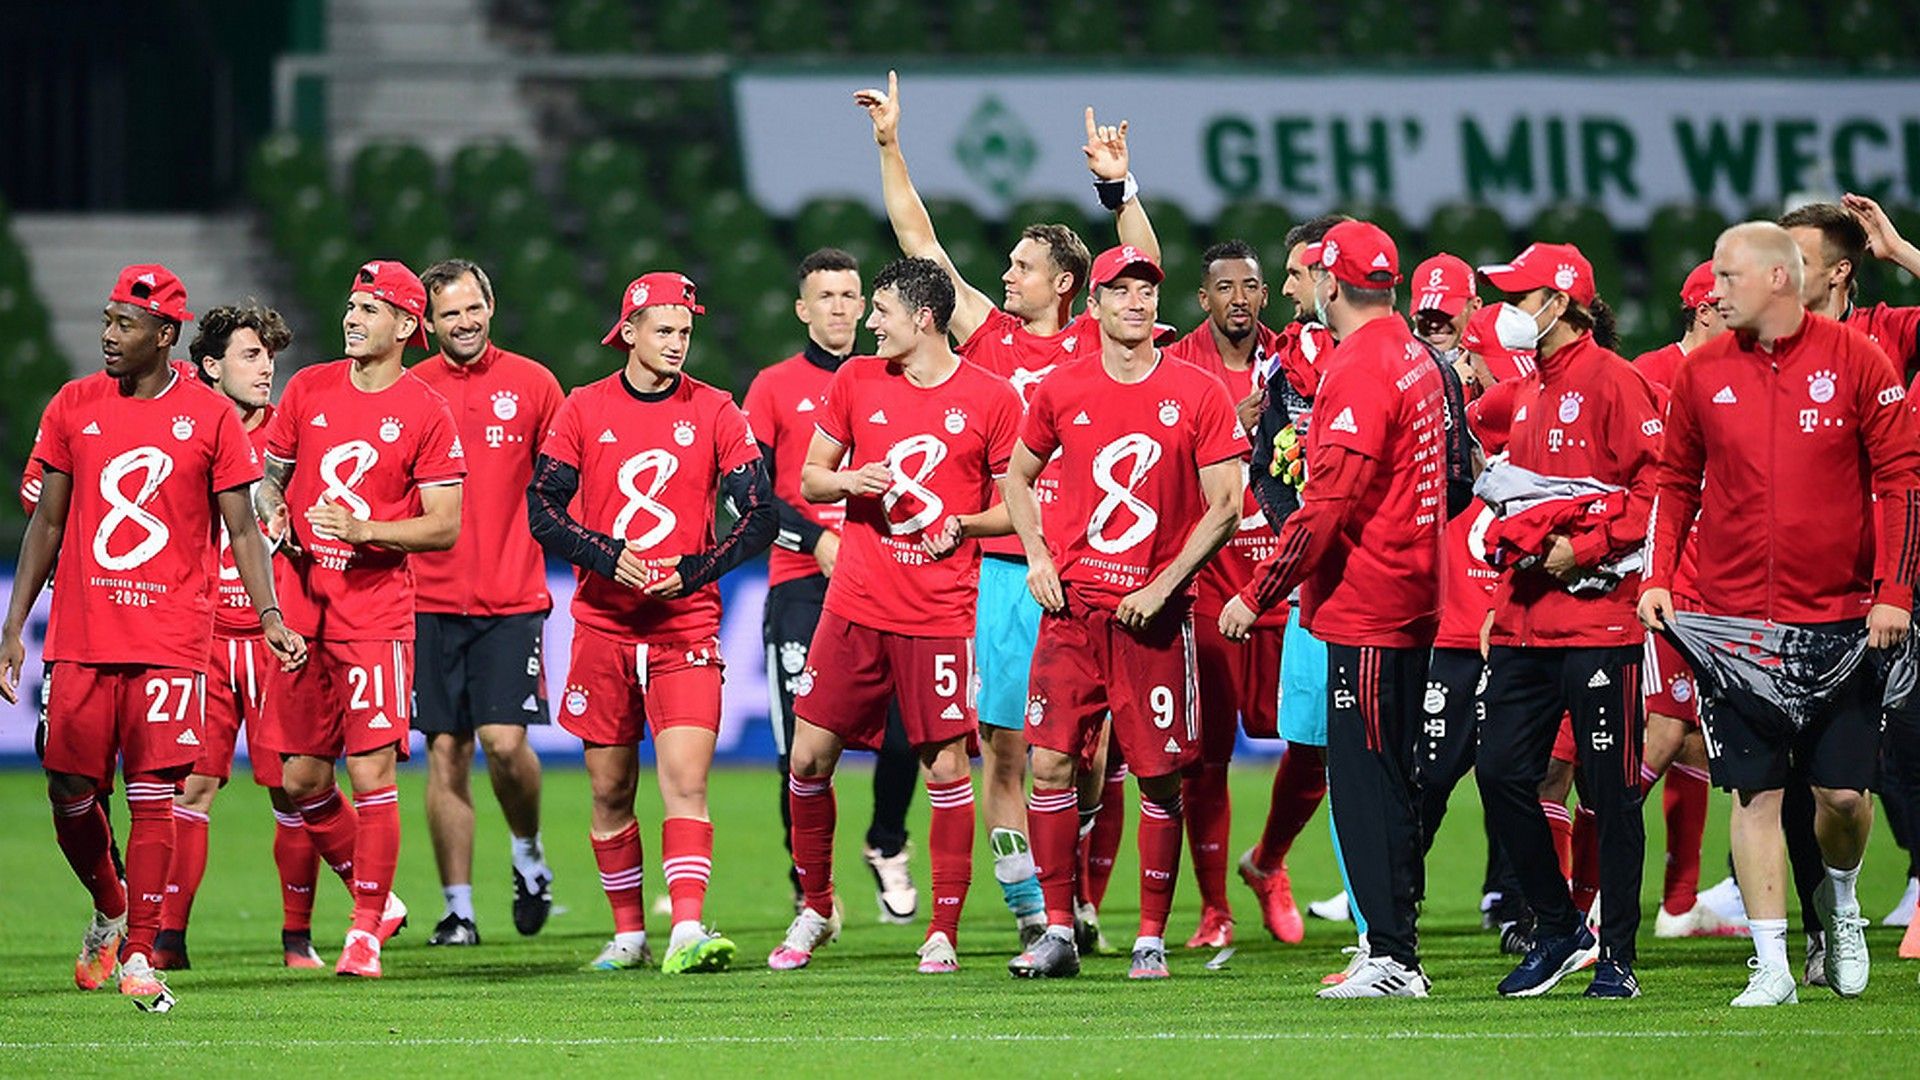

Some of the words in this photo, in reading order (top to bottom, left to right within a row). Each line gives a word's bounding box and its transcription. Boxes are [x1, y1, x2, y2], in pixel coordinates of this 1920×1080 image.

[1459, 113, 1643, 199] MIR
[1671, 114, 1920, 199] WEC
[1428, 268, 1444, 287] 8
[612, 448, 679, 552] 8
[882, 433, 948, 536] 8
[1087, 433, 1162, 554] 8
[93, 446, 174, 571] 8
[223, 594, 252, 608] -202
[347, 664, 384, 711] 21
[934, 654, 957, 698] 5
[145, 677, 193, 723] 27
[1150, 685, 1174, 729] 9
